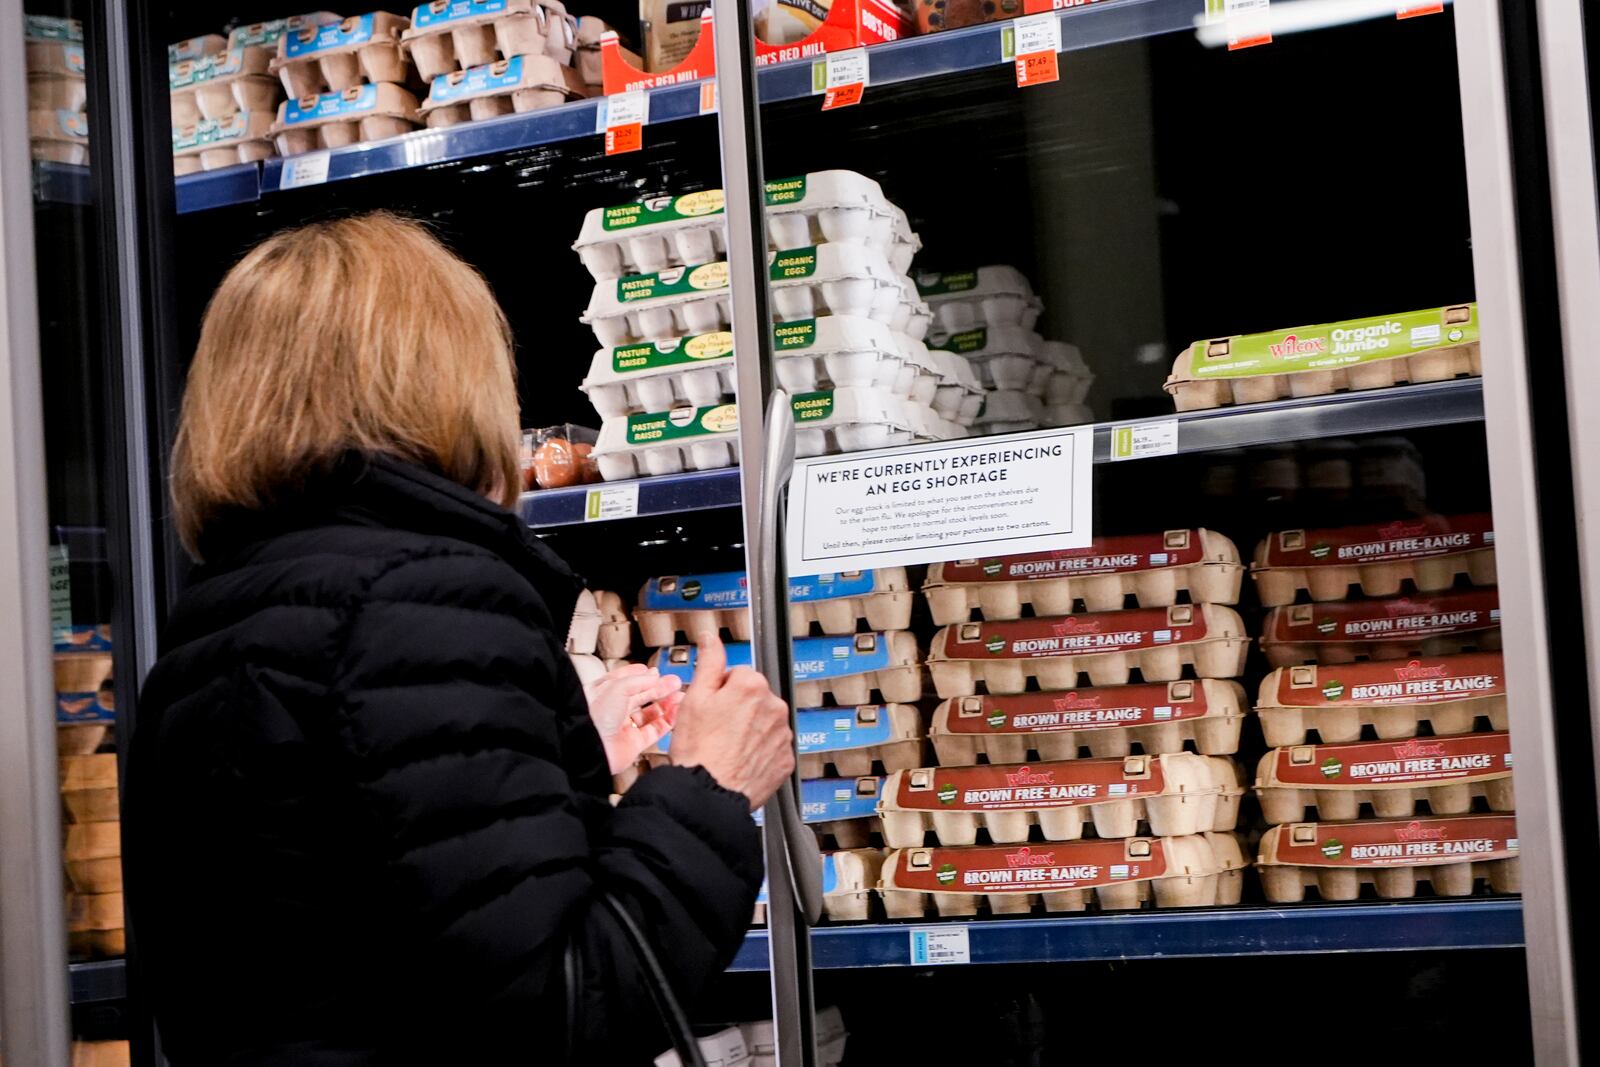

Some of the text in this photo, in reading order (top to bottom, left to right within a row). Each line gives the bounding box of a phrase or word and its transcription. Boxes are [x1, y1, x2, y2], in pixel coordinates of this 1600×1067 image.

[779, 46, 800, 63] RED
[802, 42, 826, 59] MILL
[1017, 59, 1027, 82] SALE
[765, 180, 803, 193] ORGANIC
[772, 191, 794, 201] EGGS
[606, 205, 641, 218] PASTURE
[609, 215, 637, 226] RAISED
[777, 255, 814, 268] ORGANIC
[784, 265, 806, 276] EGGS
[621, 278, 655, 291] PASTURE
[624, 288, 652, 300] RAISED
[775, 324, 812, 337] ORGANIC
[782, 334, 805, 345] EGGS
[1331, 321, 1402, 342] Organic
[616, 347, 651, 360] PASTURE
[1269, 335, 1326, 358] Wilcox
[1332, 337, 1389, 355] Jumbo
[619, 356, 647, 367] RAISED
[794, 398, 831, 410] ORGANIC
[801, 407, 823, 418] EGGS
[632, 420, 667, 433] PASTURE
[634, 430, 663, 441] RAISED
[817, 445, 1062, 484] WE'RE CURRENTLY EXPERIENCING
[866, 469, 1007, 496] AN EGG SHORTAGE
[907, 509, 939, 518] apologize
[967, 500, 1018, 510] inconvenience
[1020, 497, 1033, 505] and
[922, 518, 947, 526] normal
[822, 541, 840, 550] Until
[862, 538, 883, 548] please
[885, 535, 914, 543] consider
[916, 531, 943, 540] limiting
[945, 530, 960, 538] your
[963, 526, 995, 537] purchase
[1021, 520, 1050, 529] cartons.
[1338, 534, 1470, 559] BROWN FREE-RANGE
[1009, 554, 1138, 576] BROWN FREE-RANGE
[704, 591, 736, 603] WHITE
[1345, 611, 1478, 634] BROWN FREE-RANGE
[1012, 632, 1142, 653] BROWN FREE-RANGE
[1351, 684, 1402, 699] BROWN
[1406, 676, 1494, 694] FREE-RANGE
[1013, 708, 1142, 728] BROWN FREE-RANGE
[1350, 762, 1401, 777] BROWN
[1404, 755, 1491, 773] FREE-RANGE
[1005, 766, 1055, 786] Wilcox
[964, 789, 1012, 803] BROWN
[1015, 785, 1096, 800] FREE-RANGE
[1005, 847, 1055, 867] Wilcox
[1351, 840, 1493, 858] BROWN FREE-RANGE
[963, 870, 1012, 884] BROWN
[1015, 866, 1098, 881] FREE-RANGE
